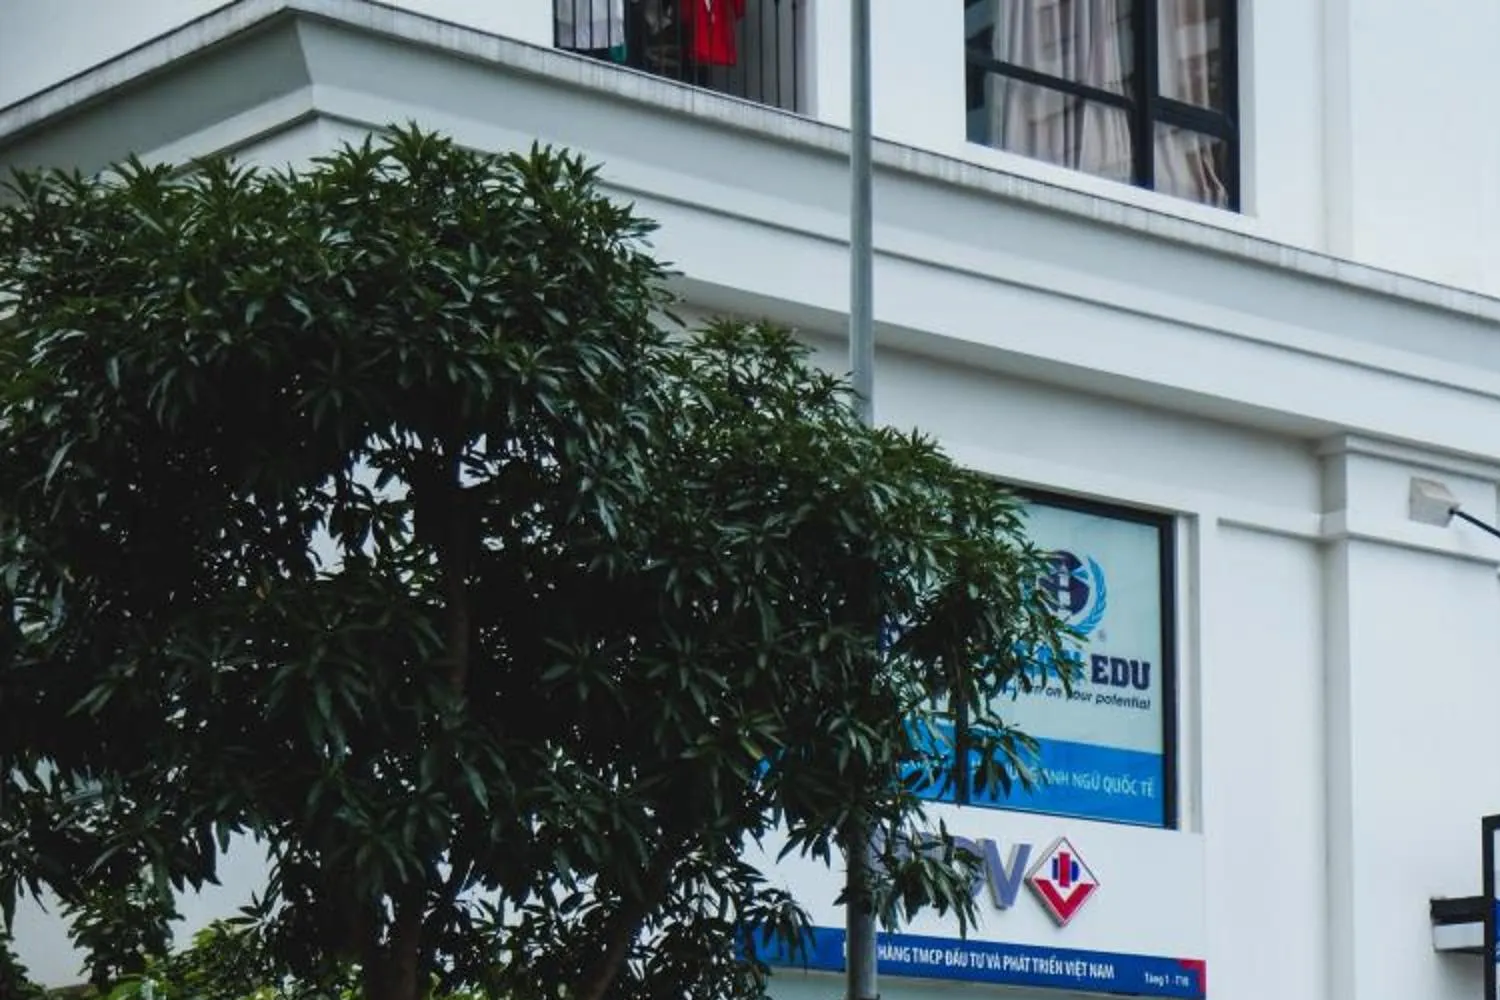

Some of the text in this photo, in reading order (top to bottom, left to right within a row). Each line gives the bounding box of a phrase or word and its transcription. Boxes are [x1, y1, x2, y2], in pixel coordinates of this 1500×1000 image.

[1091, 654, 1151, 691] EDU
[1095, 693, 1151, 711] potential
[877, 942, 911, 963] HÀNG
[913, 946, 943, 965] TMCP
[1003, 951, 1031, 973] PHÁT
[1065, 958, 1088, 981] VIỆT
[1089, 963, 1115, 979] NAM
